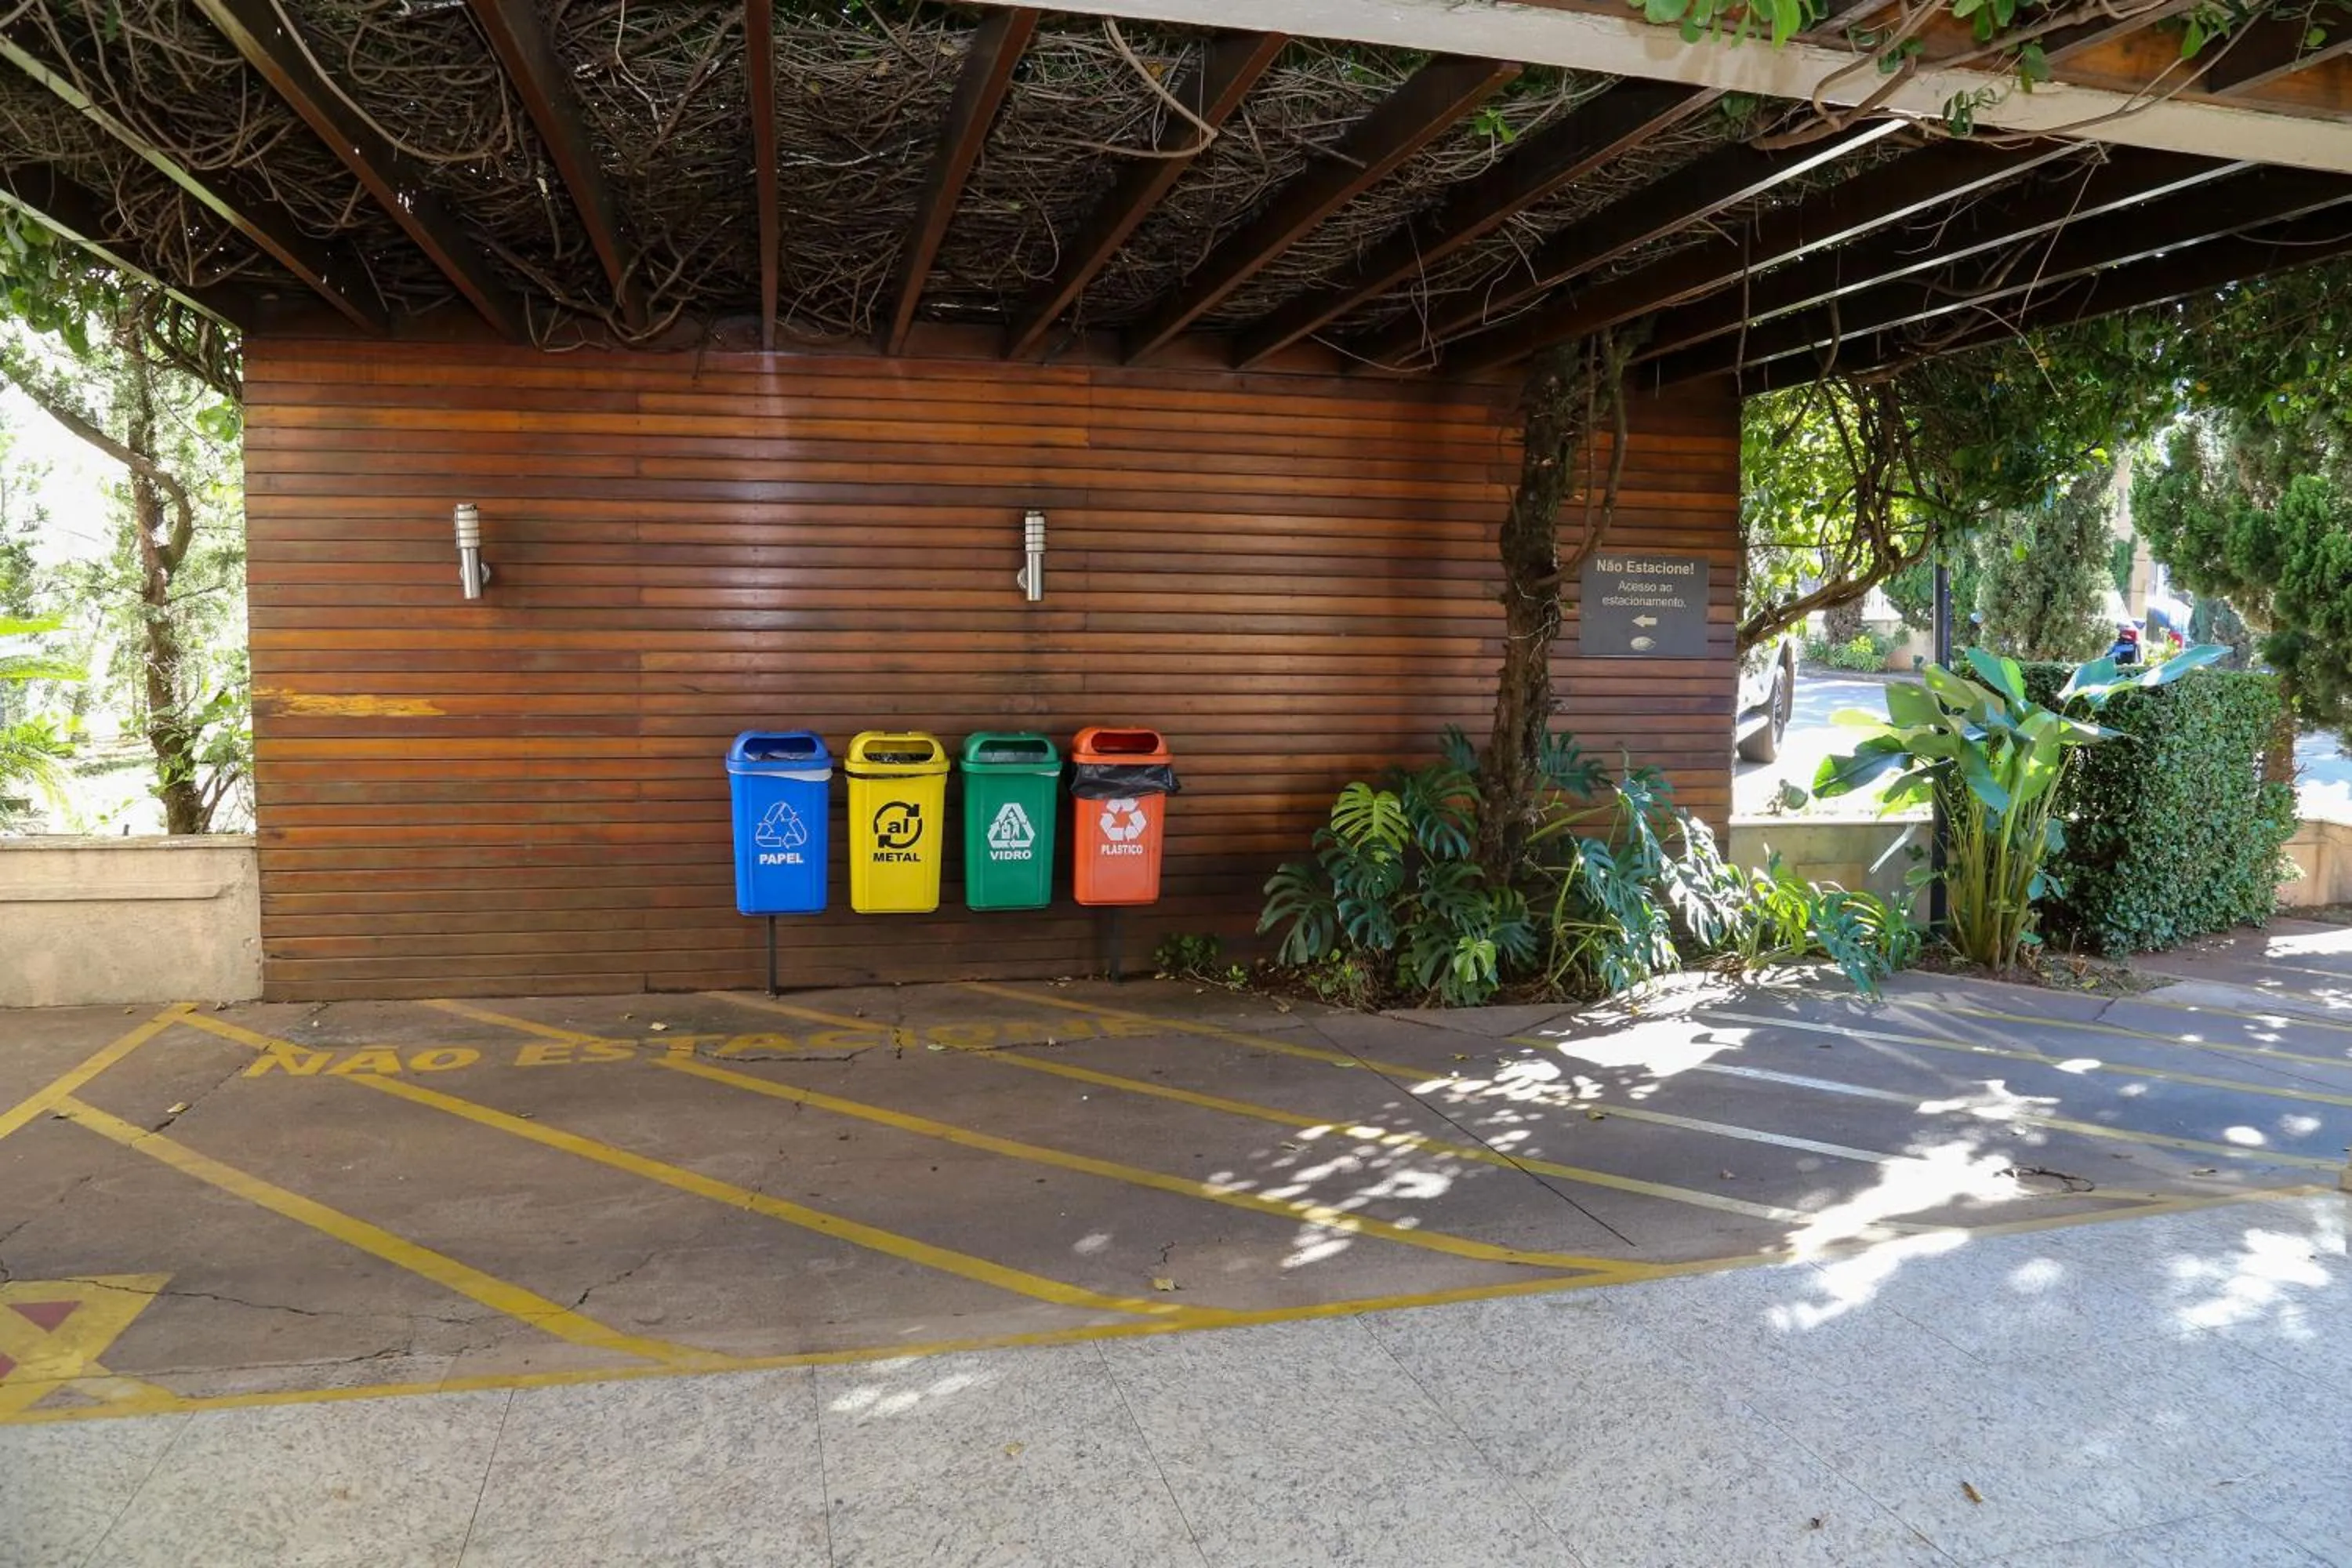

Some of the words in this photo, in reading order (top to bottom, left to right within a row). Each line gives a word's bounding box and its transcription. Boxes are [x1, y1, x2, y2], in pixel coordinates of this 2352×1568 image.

[1596, 558, 1622, 572] Não
[1627, 561, 1694, 575] Estacione!
[1617, 580, 1656, 592] Acesso
[1660, 583, 1672, 592] ao
[1602, 596, 1686, 608] estacionamento.
[887, 818, 909, 833] al
[760, 853, 803, 864] PAPEL
[873, 852, 920, 862] METAL
[990, 850, 1032, 860] VIDRO
[241, 1044, 481, 1077] NÃO
